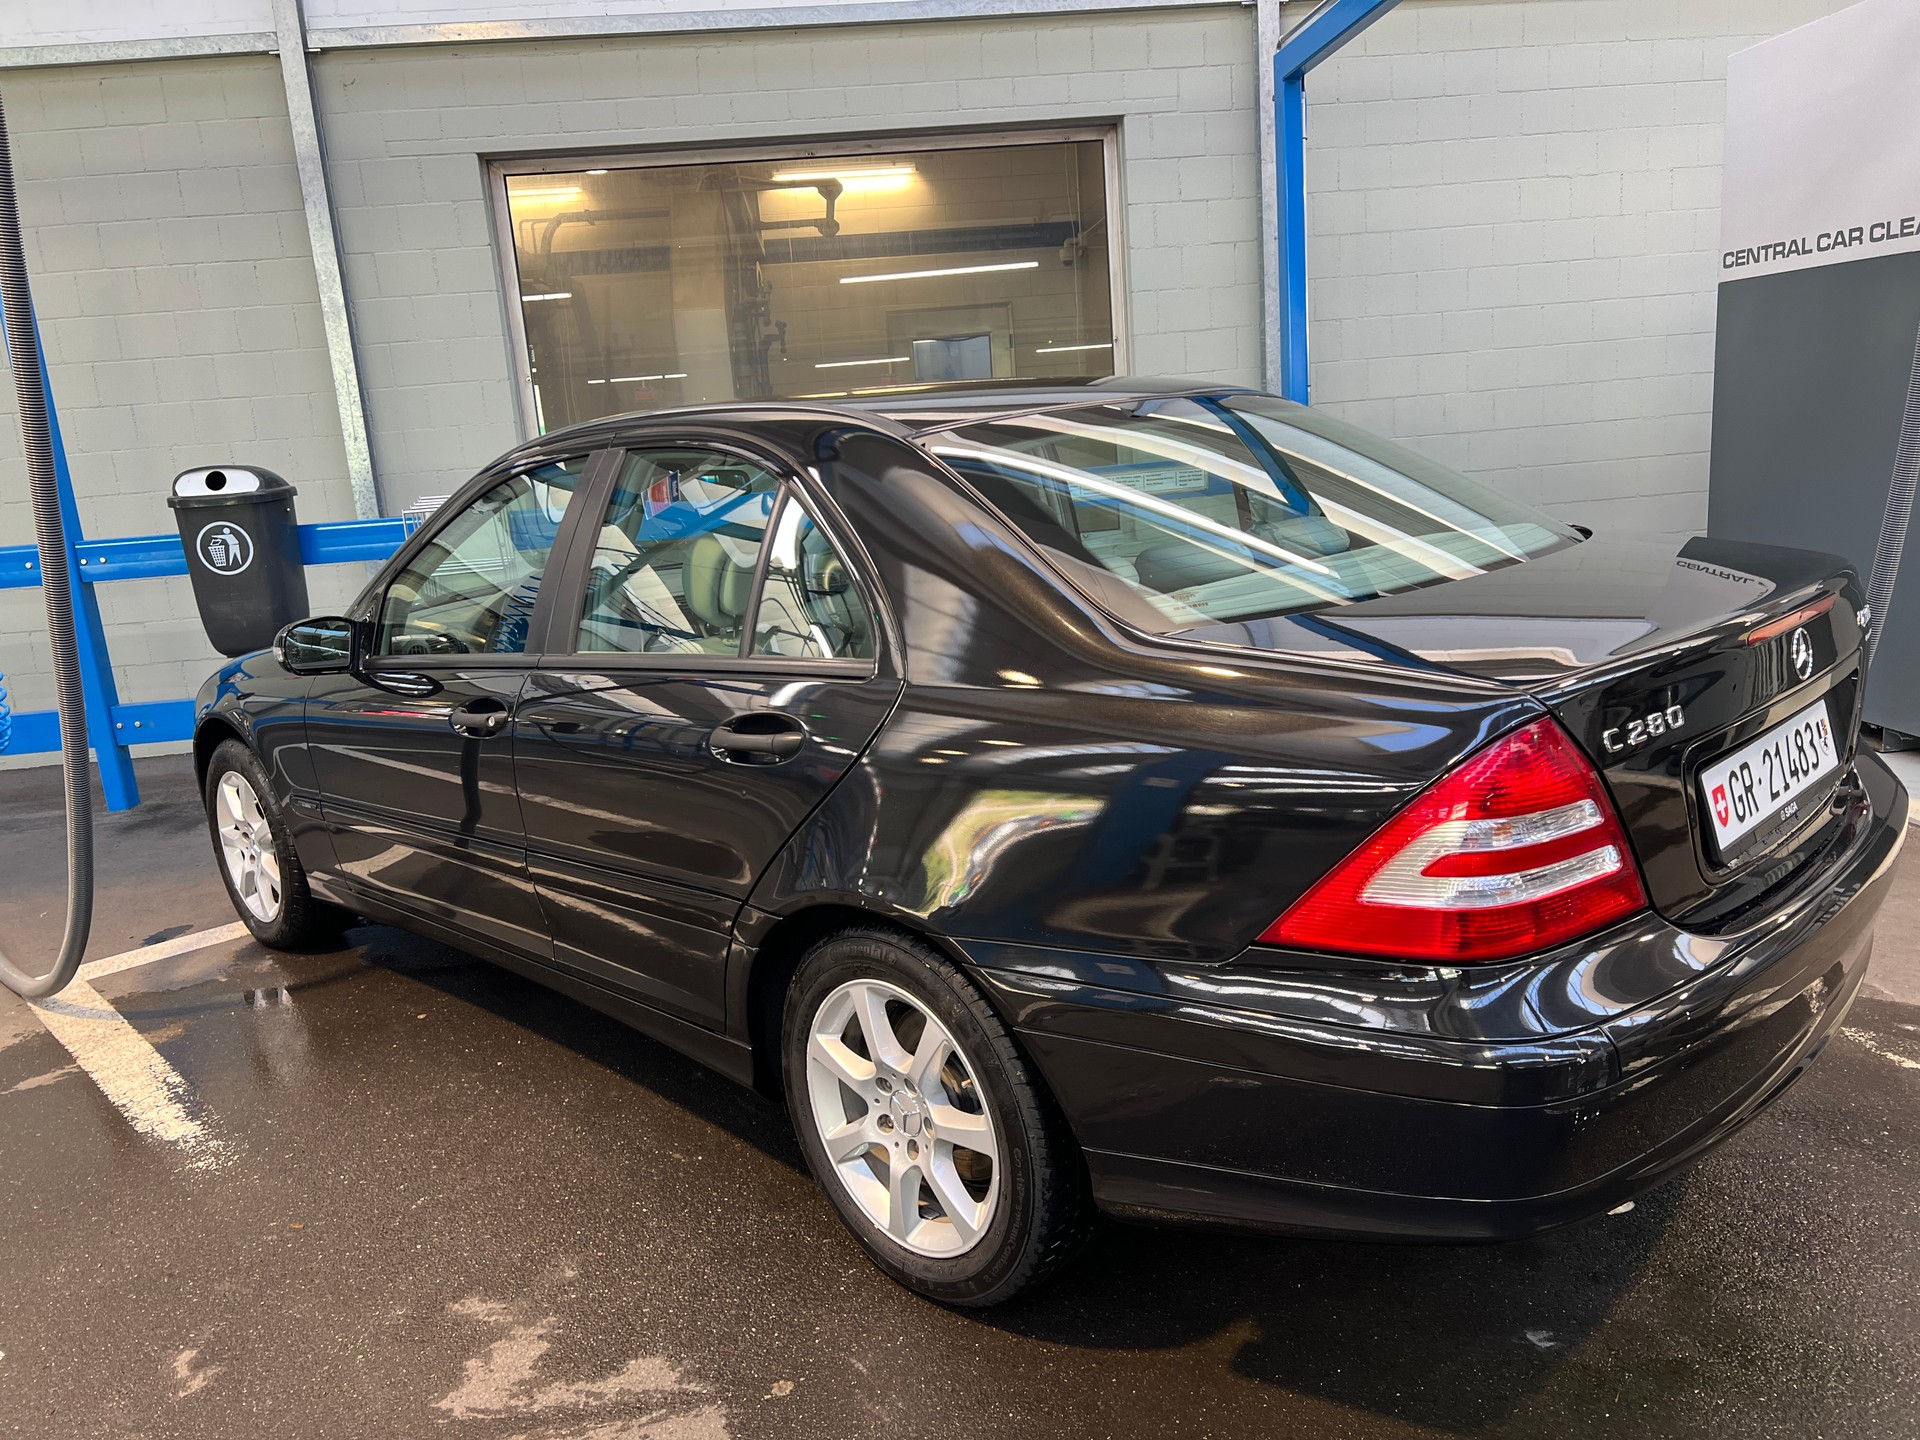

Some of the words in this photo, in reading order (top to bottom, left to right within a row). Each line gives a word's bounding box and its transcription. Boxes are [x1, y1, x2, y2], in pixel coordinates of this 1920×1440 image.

[1722, 237, 1813, 269] CENTRAL
[1816, 227, 1864, 252] CAR
[1602, 727, 1624, 754] C
[1626, 704, 1685, 746] 280
[1785, 801, 1799, 817] SAGA
